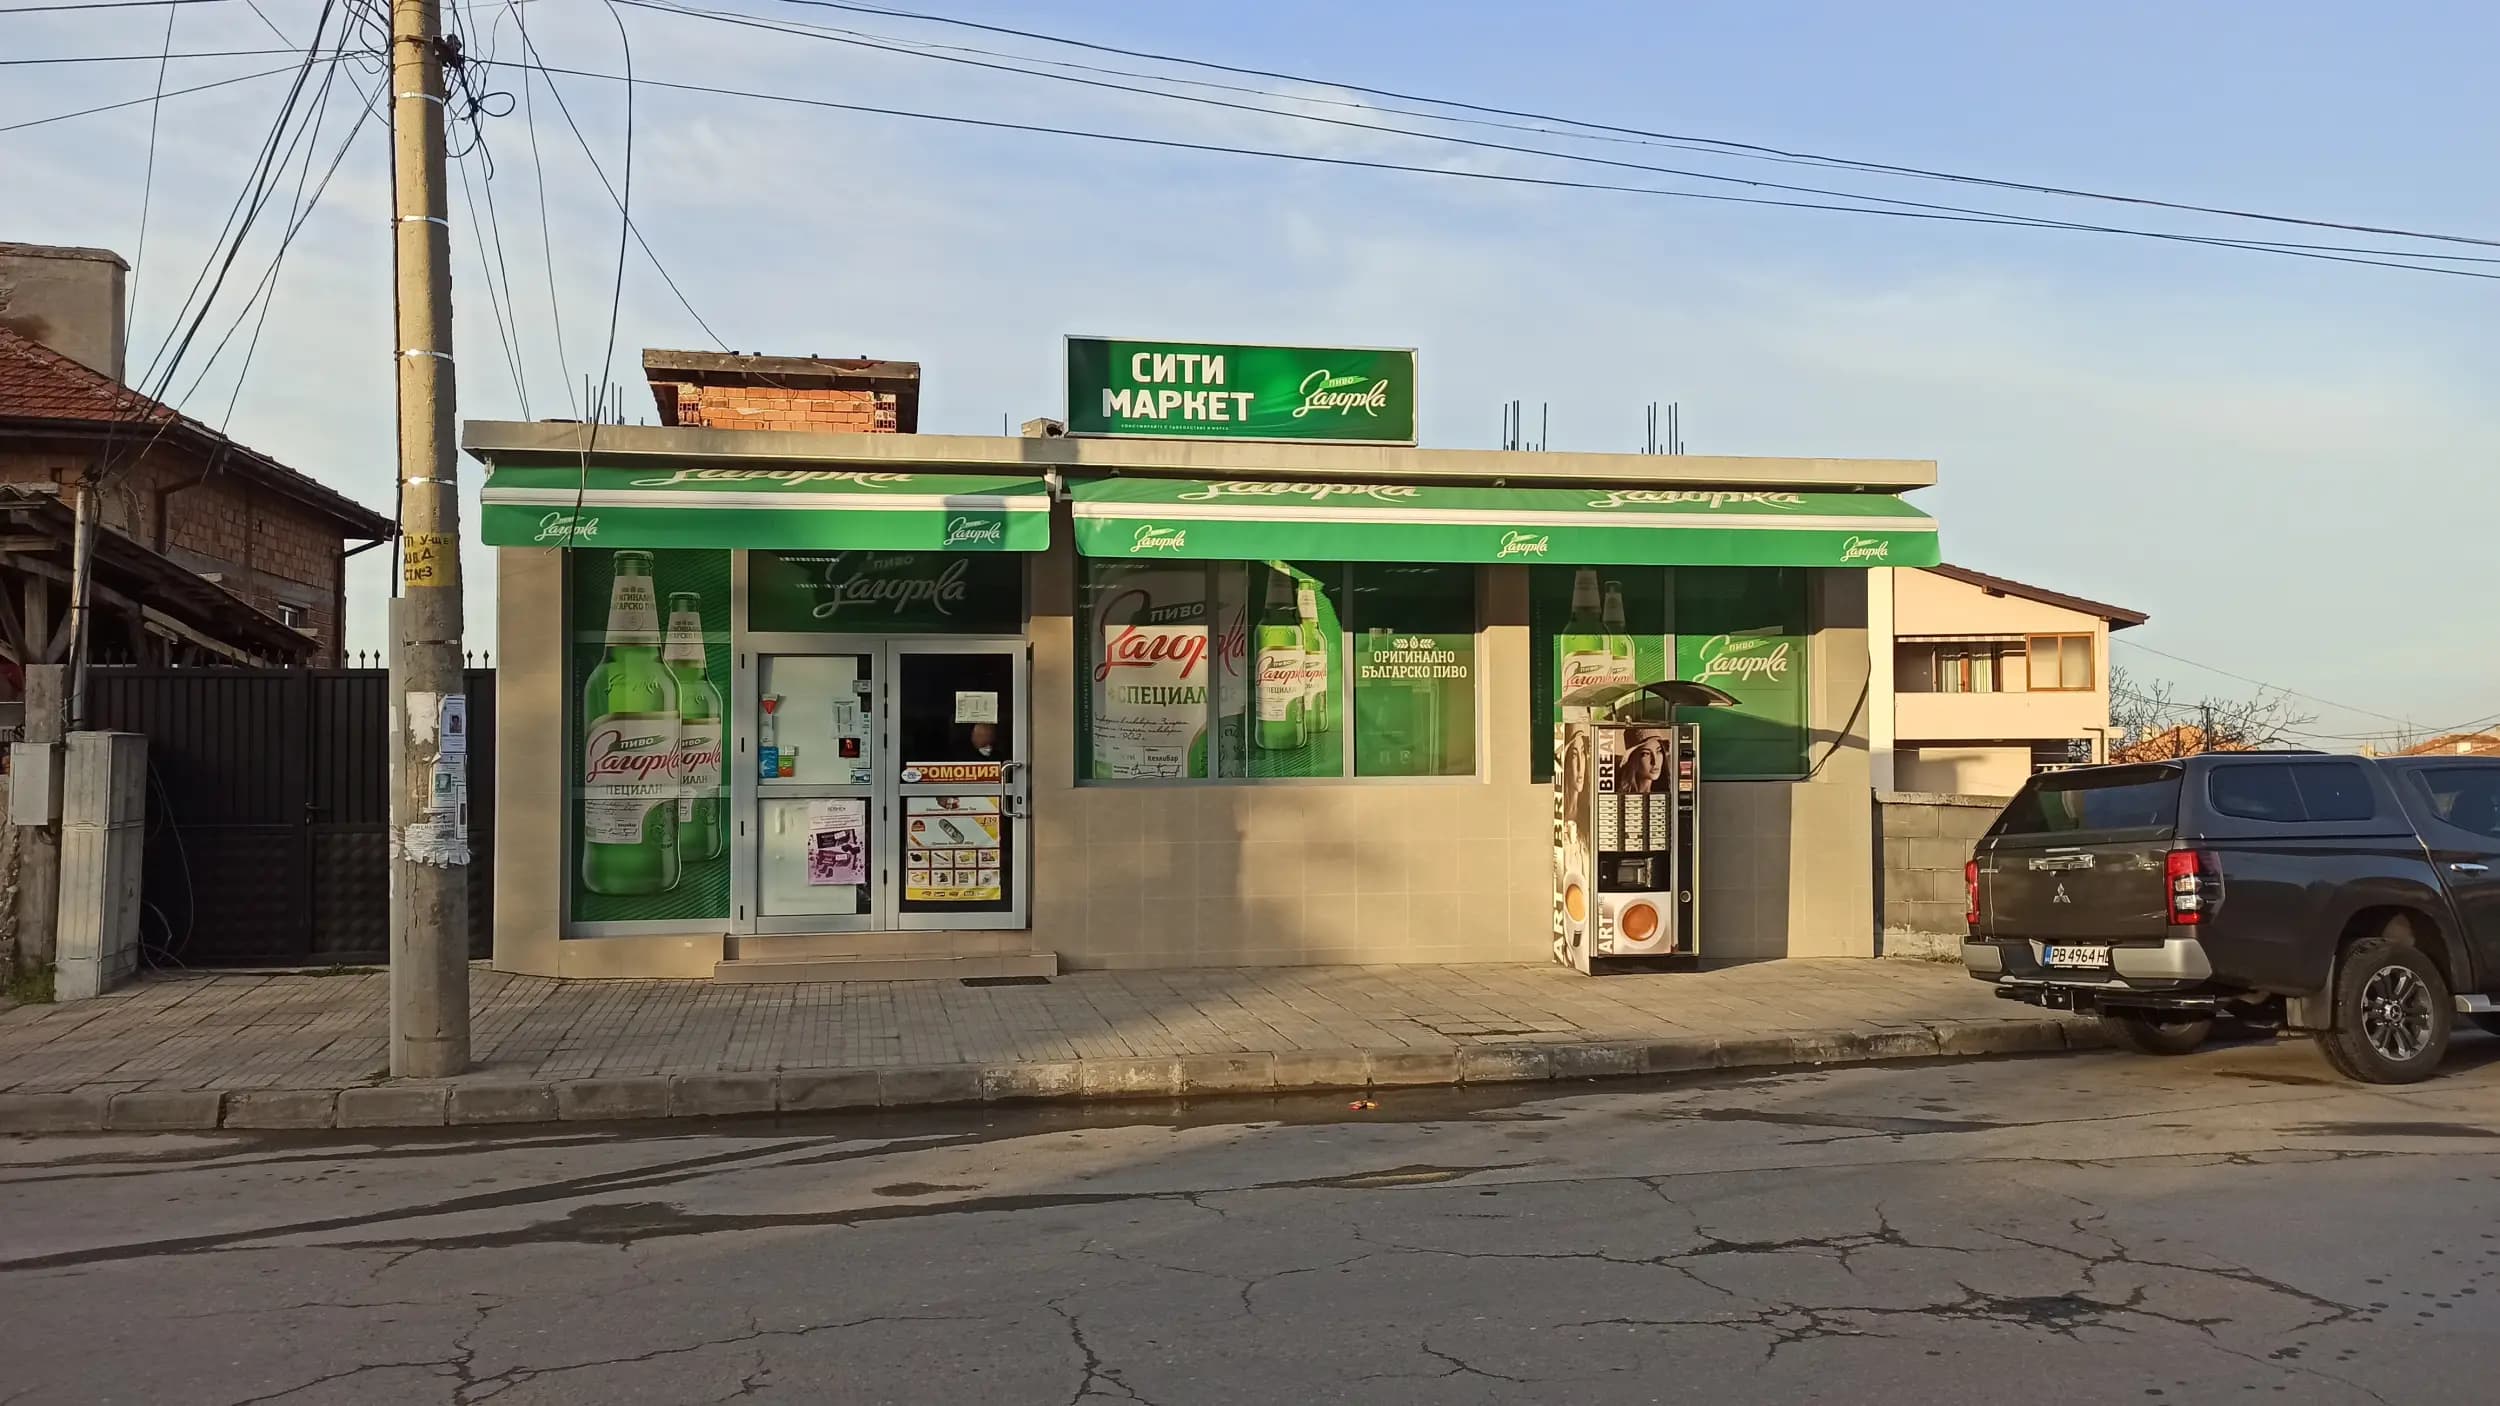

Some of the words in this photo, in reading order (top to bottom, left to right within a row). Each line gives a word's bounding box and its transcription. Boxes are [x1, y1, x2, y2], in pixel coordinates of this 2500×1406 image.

[1131, 352, 1225, 385] СИТИ
[1102, 388, 1255, 421] МАРКЕТ
[1292, 369, 1388, 417] Загорка
[943, 516, 1001, 545] Загорка
[1130, 524, 1186, 552] Загорка
[1497, 530, 1549, 558] Загорка
[1840, 536, 1889, 562] Загорка
[1151, 604, 1205, 622] ПИВО
[1374, 651, 1455, 663] ОРИГИНАЛНО
[1692, 634, 1789, 684] Загорка
[1361, 666, 1430, 678] БЪЛГАРСКО
[1433, 666, 1467, 678] ПИВО
[621, 738, 654, 749] ПИВО
[919, 766, 999, 780] РОМОЦИЯ
[1600, 729, 1613, 791] BREAK
[1552, 873, 1564, 964] ART
[1598, 917, 1613, 954] ART
[2052, 948, 2066, 962] PB
[2068, 949, 2095, 962] 4964
